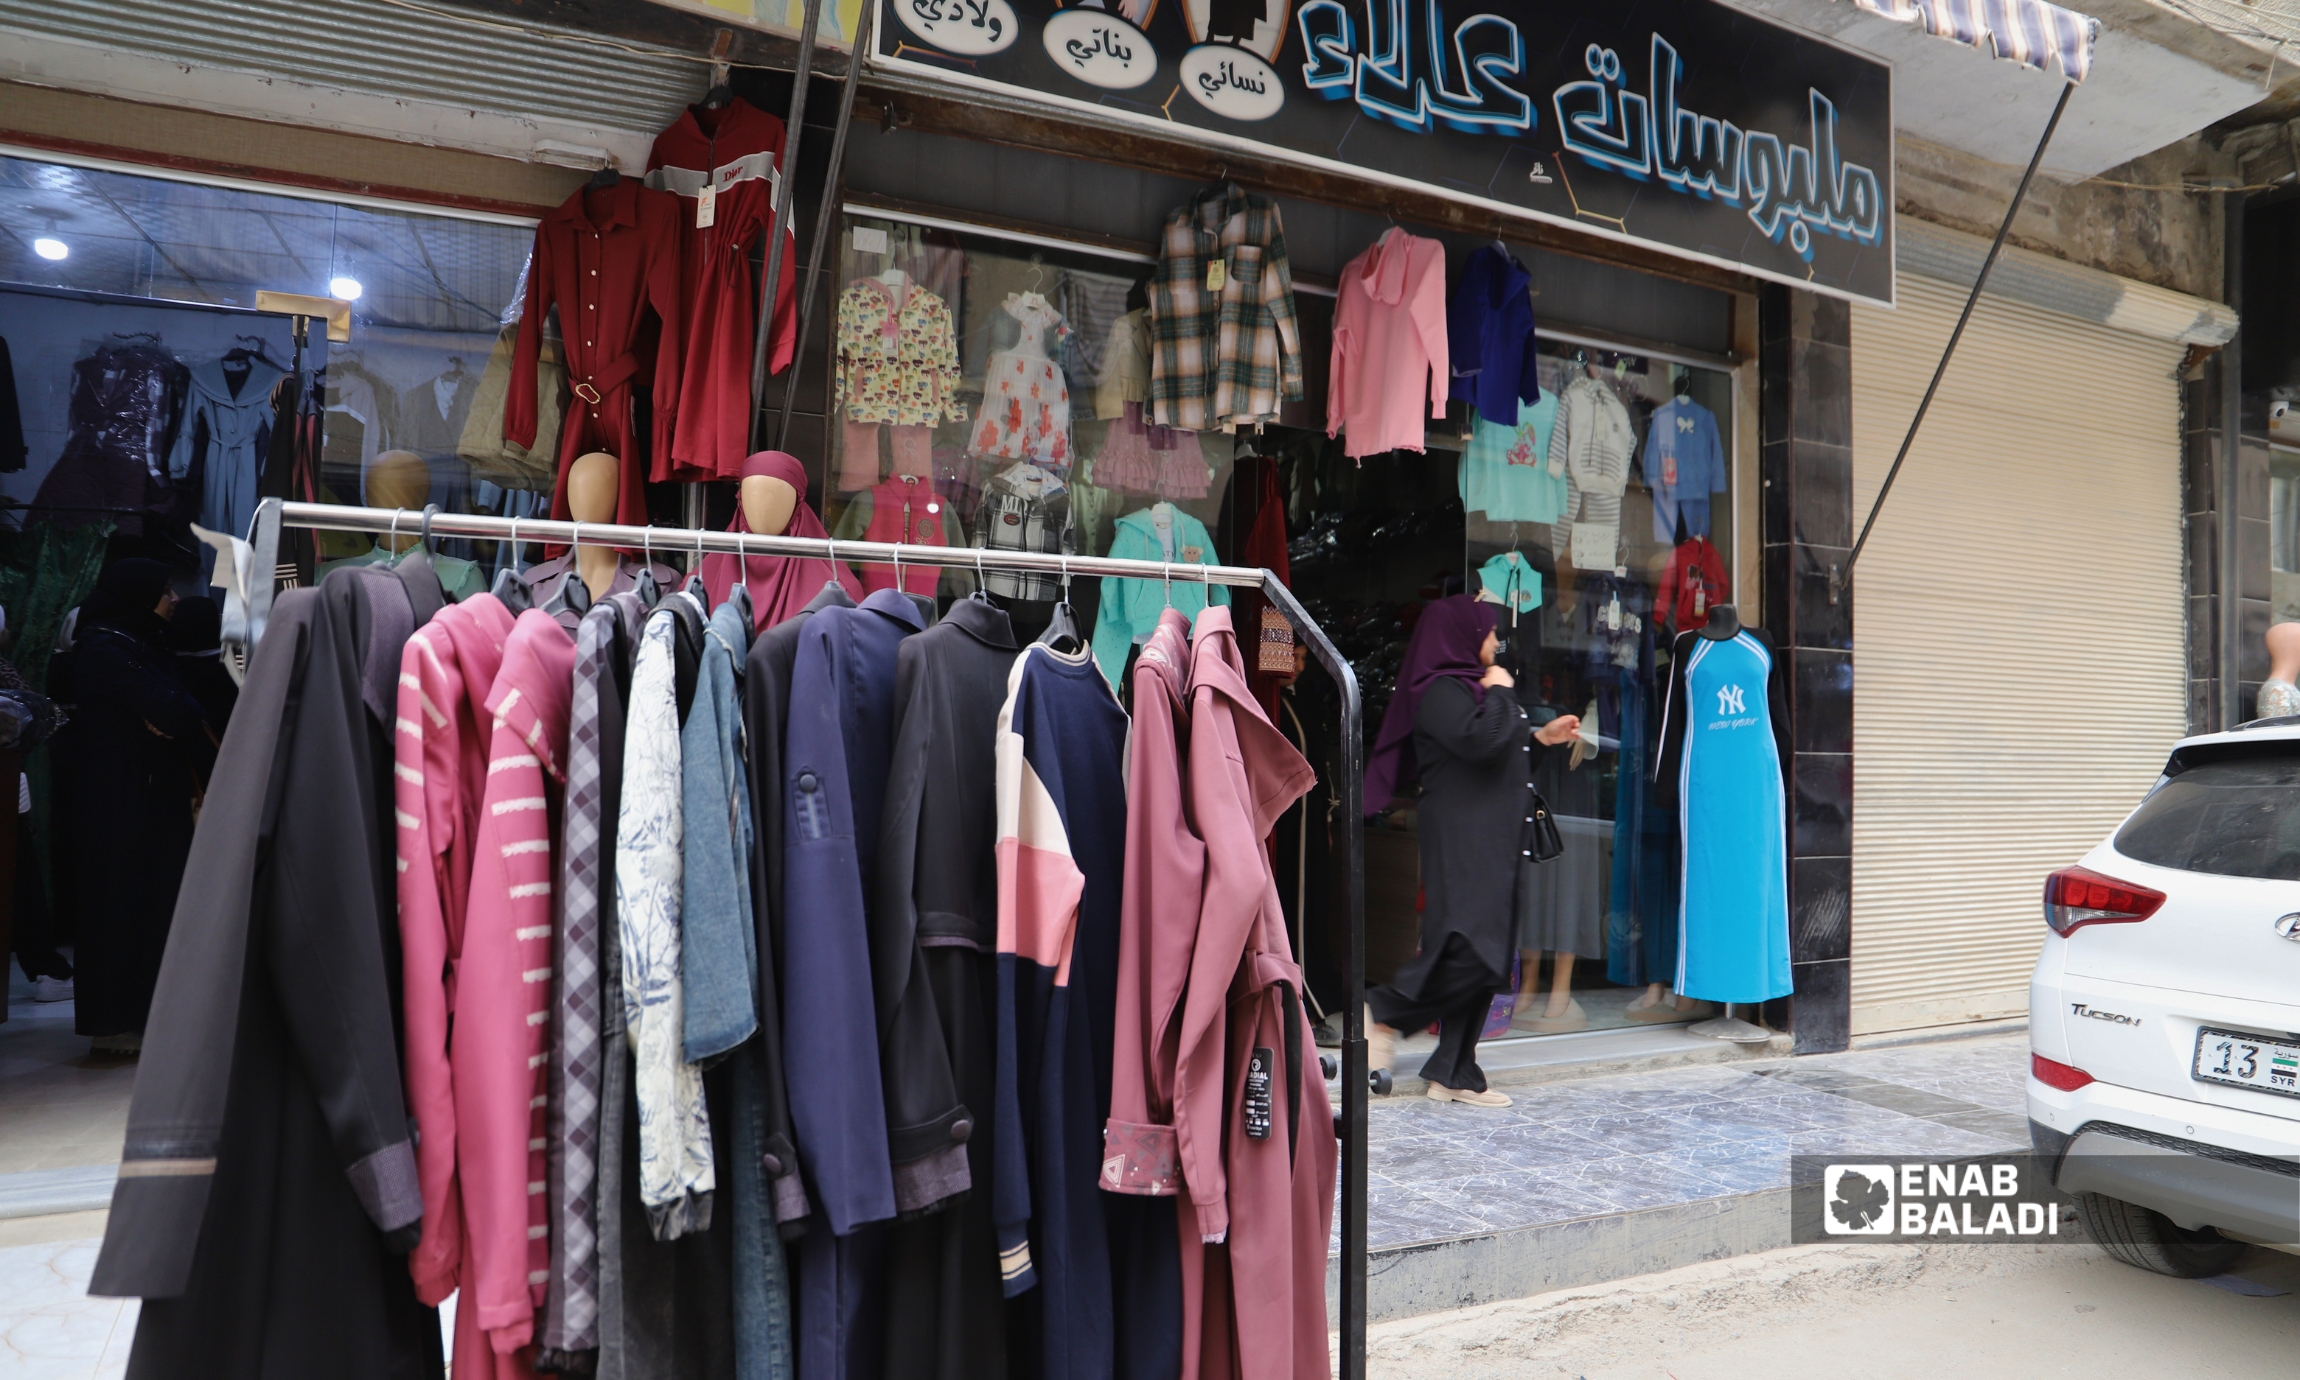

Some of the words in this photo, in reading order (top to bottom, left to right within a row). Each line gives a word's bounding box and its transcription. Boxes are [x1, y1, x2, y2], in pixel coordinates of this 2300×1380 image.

[913, 0, 1003, 42] ولادي
[1066, 28, 1133, 68] بناتي
[1297, 0, 1535, 133] علاء
[1198, 62, 1266, 100] نسائي
[1552, 31, 1883, 256] ملبوسات
[1717, 684, 1746, 716] NY
[1709, 720, 1731, 730] NEW
[1732, 718, 1758, 730] YORK
[2213, 1041, 2260, 1079] 13
[2274, 1048, 2299, 1060] سورية
[1249, 1072, 1268, 1080] ADIAL
[2270, 1075, 2296, 1088] SYR
